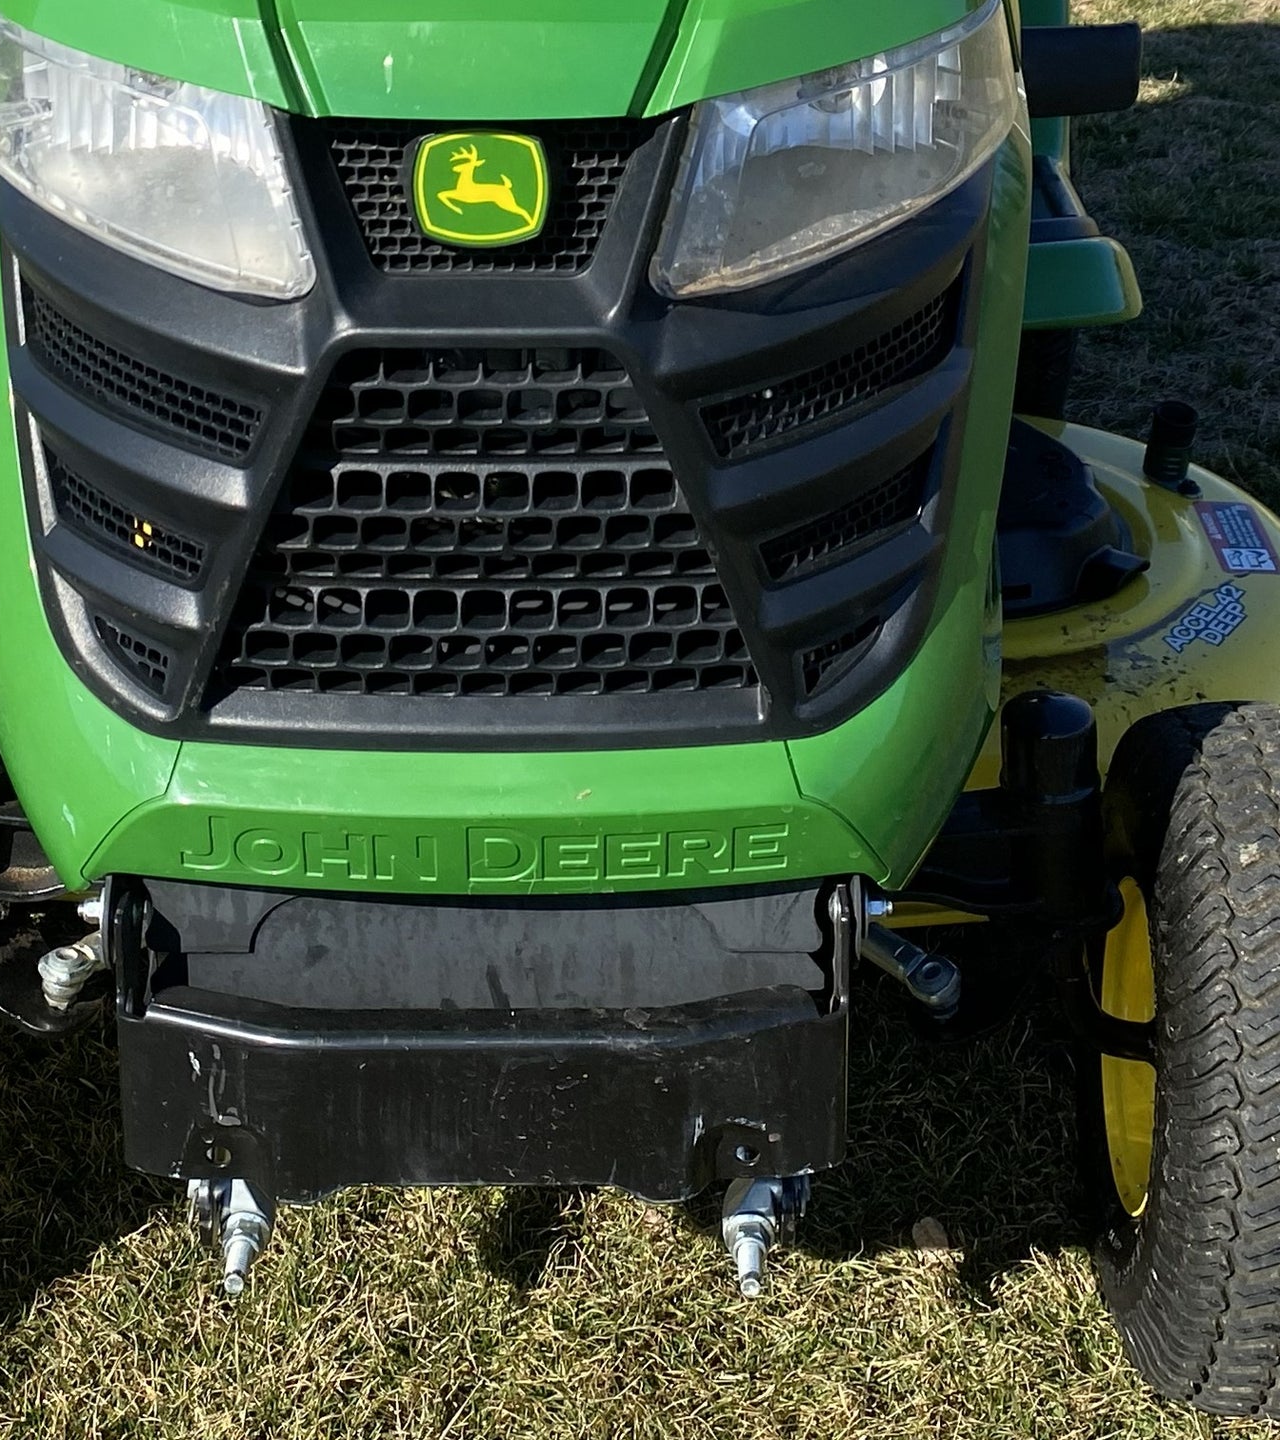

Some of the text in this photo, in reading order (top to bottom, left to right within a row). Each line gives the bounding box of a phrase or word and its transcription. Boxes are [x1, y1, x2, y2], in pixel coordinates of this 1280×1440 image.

[1199, 602, 1246, 645] DEEP
[180, 815, 788, 881] JOHN DEERE
